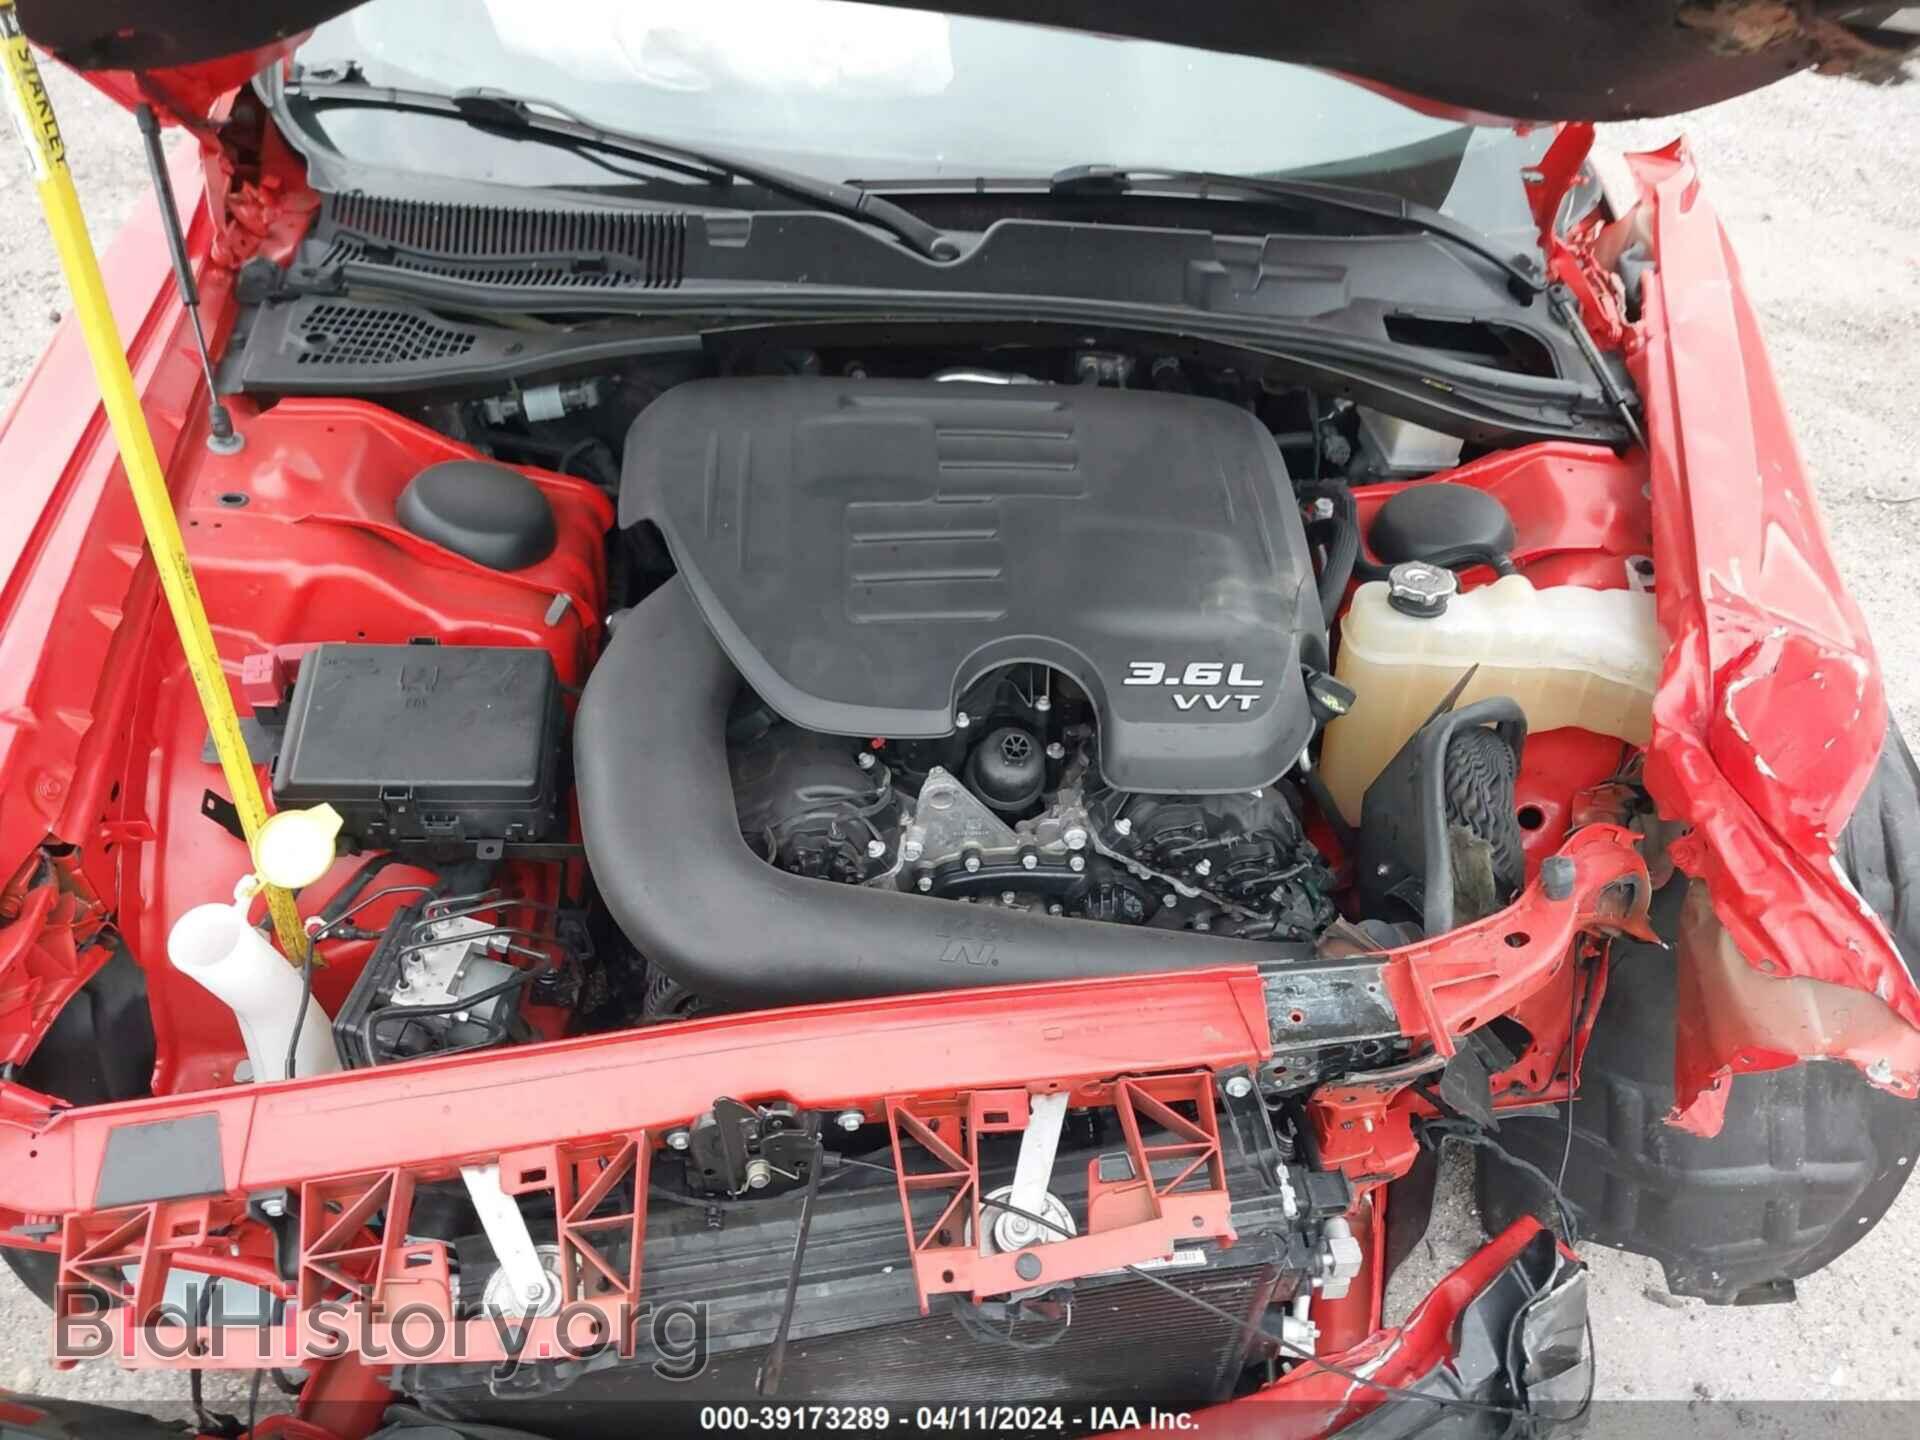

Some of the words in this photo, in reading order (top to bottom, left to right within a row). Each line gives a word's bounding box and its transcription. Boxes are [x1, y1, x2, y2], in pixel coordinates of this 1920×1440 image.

[17, 47, 66, 164] STANLEY
[1123, 661, 1265, 687] 3.6L
[1172, 693, 1262, 711] VVT
